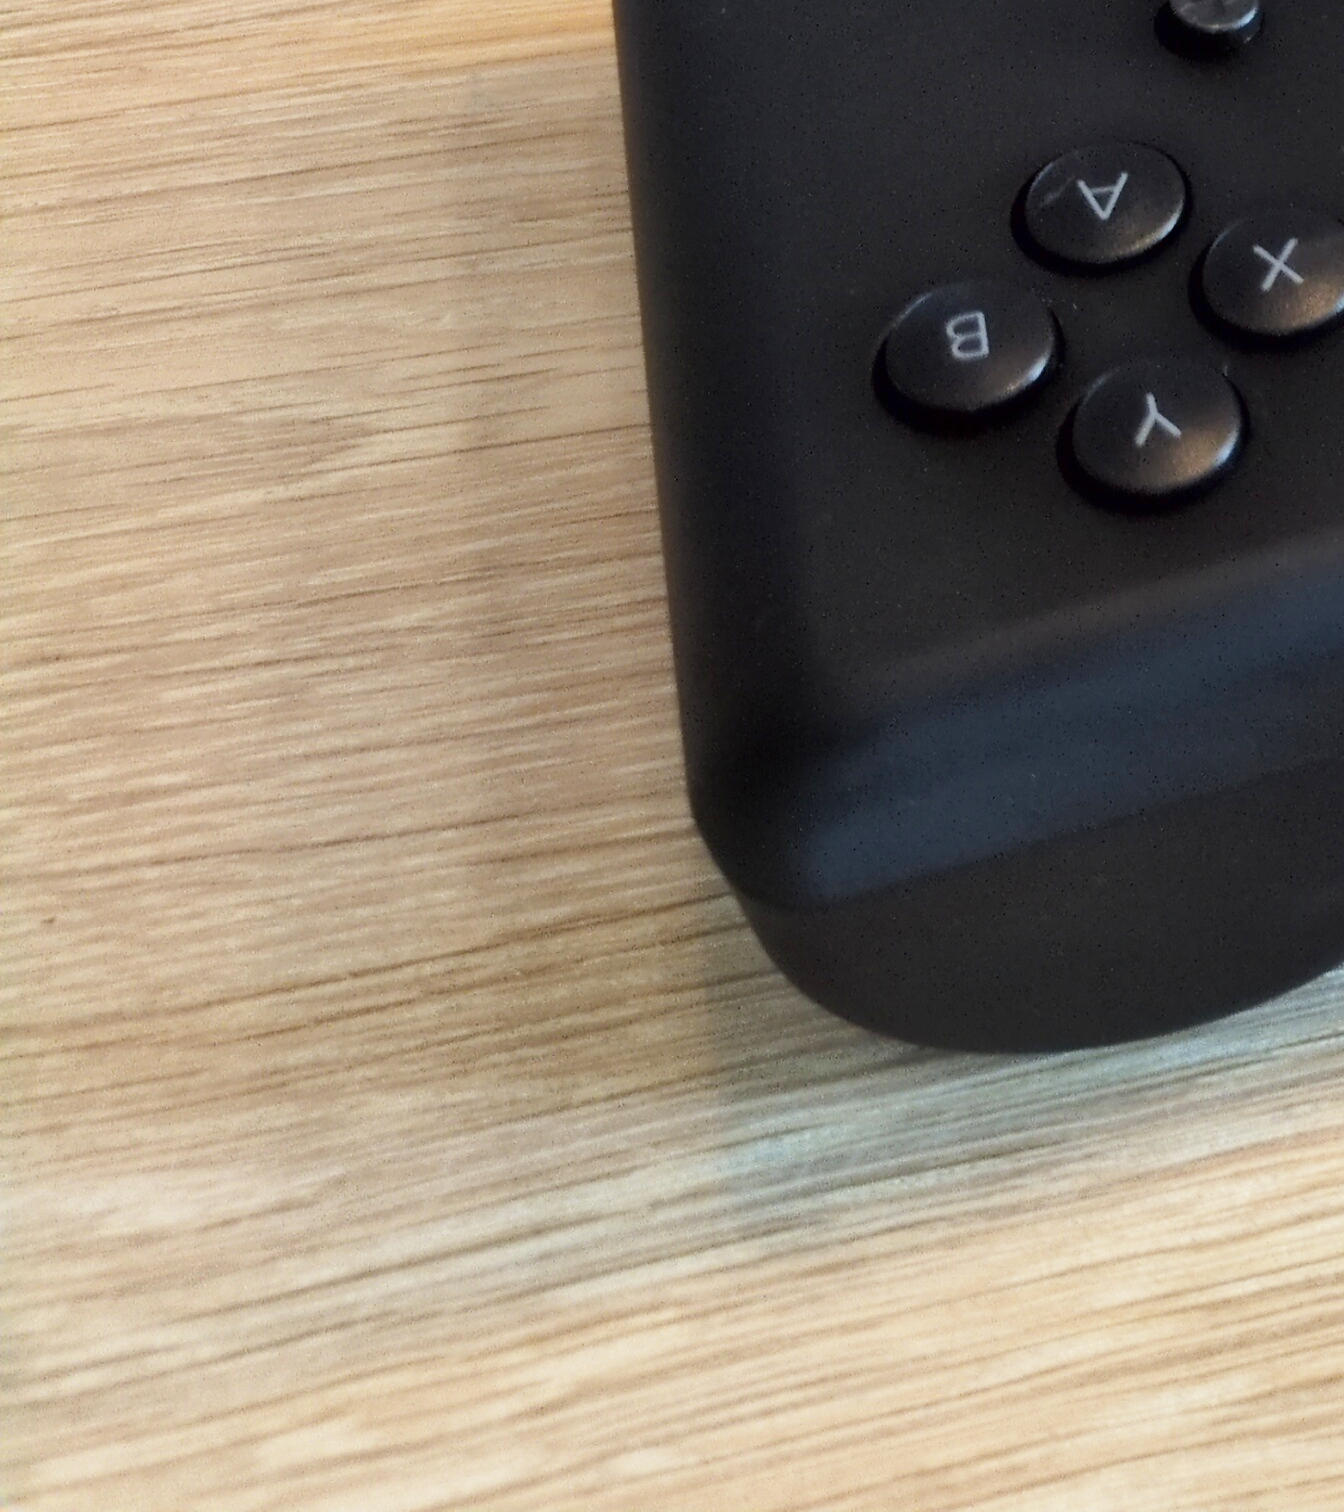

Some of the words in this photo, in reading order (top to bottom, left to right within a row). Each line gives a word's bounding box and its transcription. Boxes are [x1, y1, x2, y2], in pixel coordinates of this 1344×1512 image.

[1076, 171, 1129, 222] A
[1252, 237, 1305, 292] X
[945, 309, 990, 362] B
[1134, 391, 1183, 448] Y
